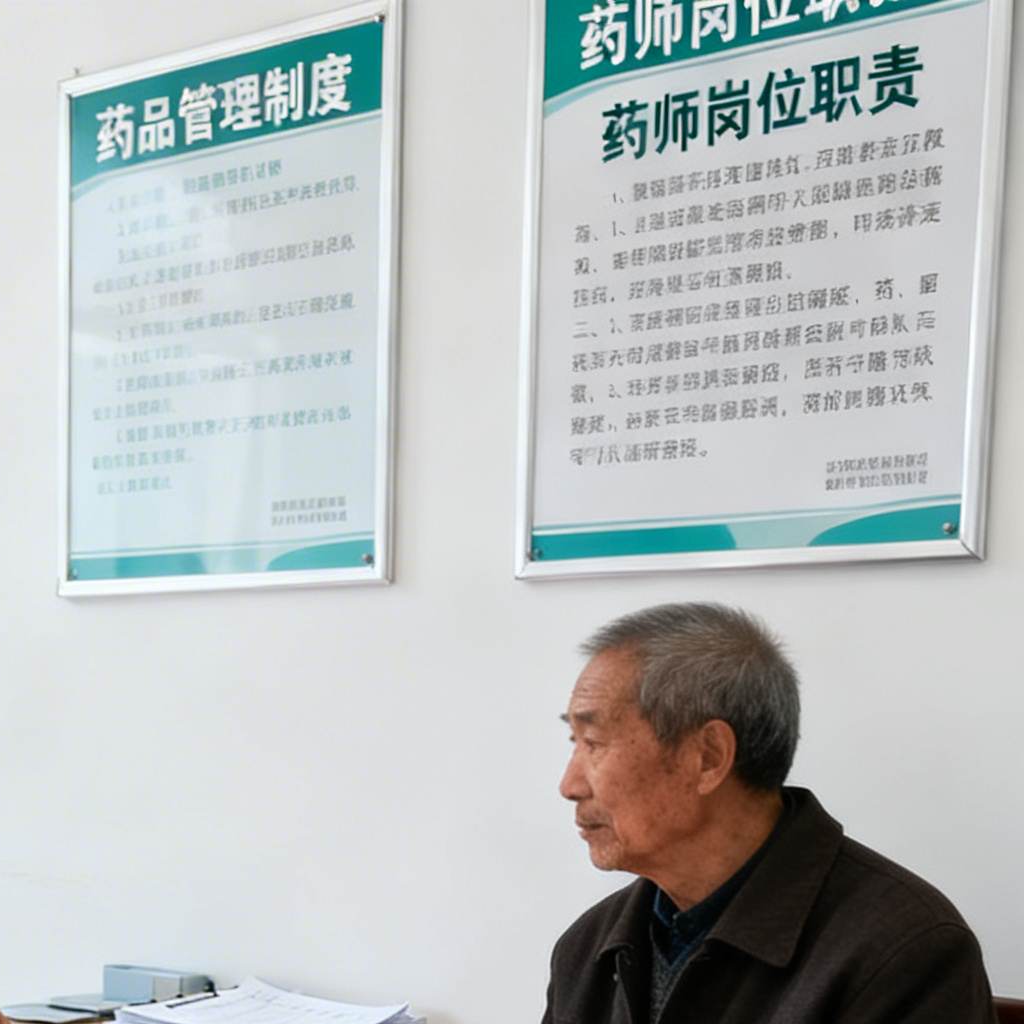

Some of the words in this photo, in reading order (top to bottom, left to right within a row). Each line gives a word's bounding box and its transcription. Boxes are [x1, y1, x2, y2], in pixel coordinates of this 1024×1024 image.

[578, 0, 902, 70] 药师岗位
[95, 53, 352, 163] 药品管理制度
[601, 44, 924, 163] 药师岗位职责
